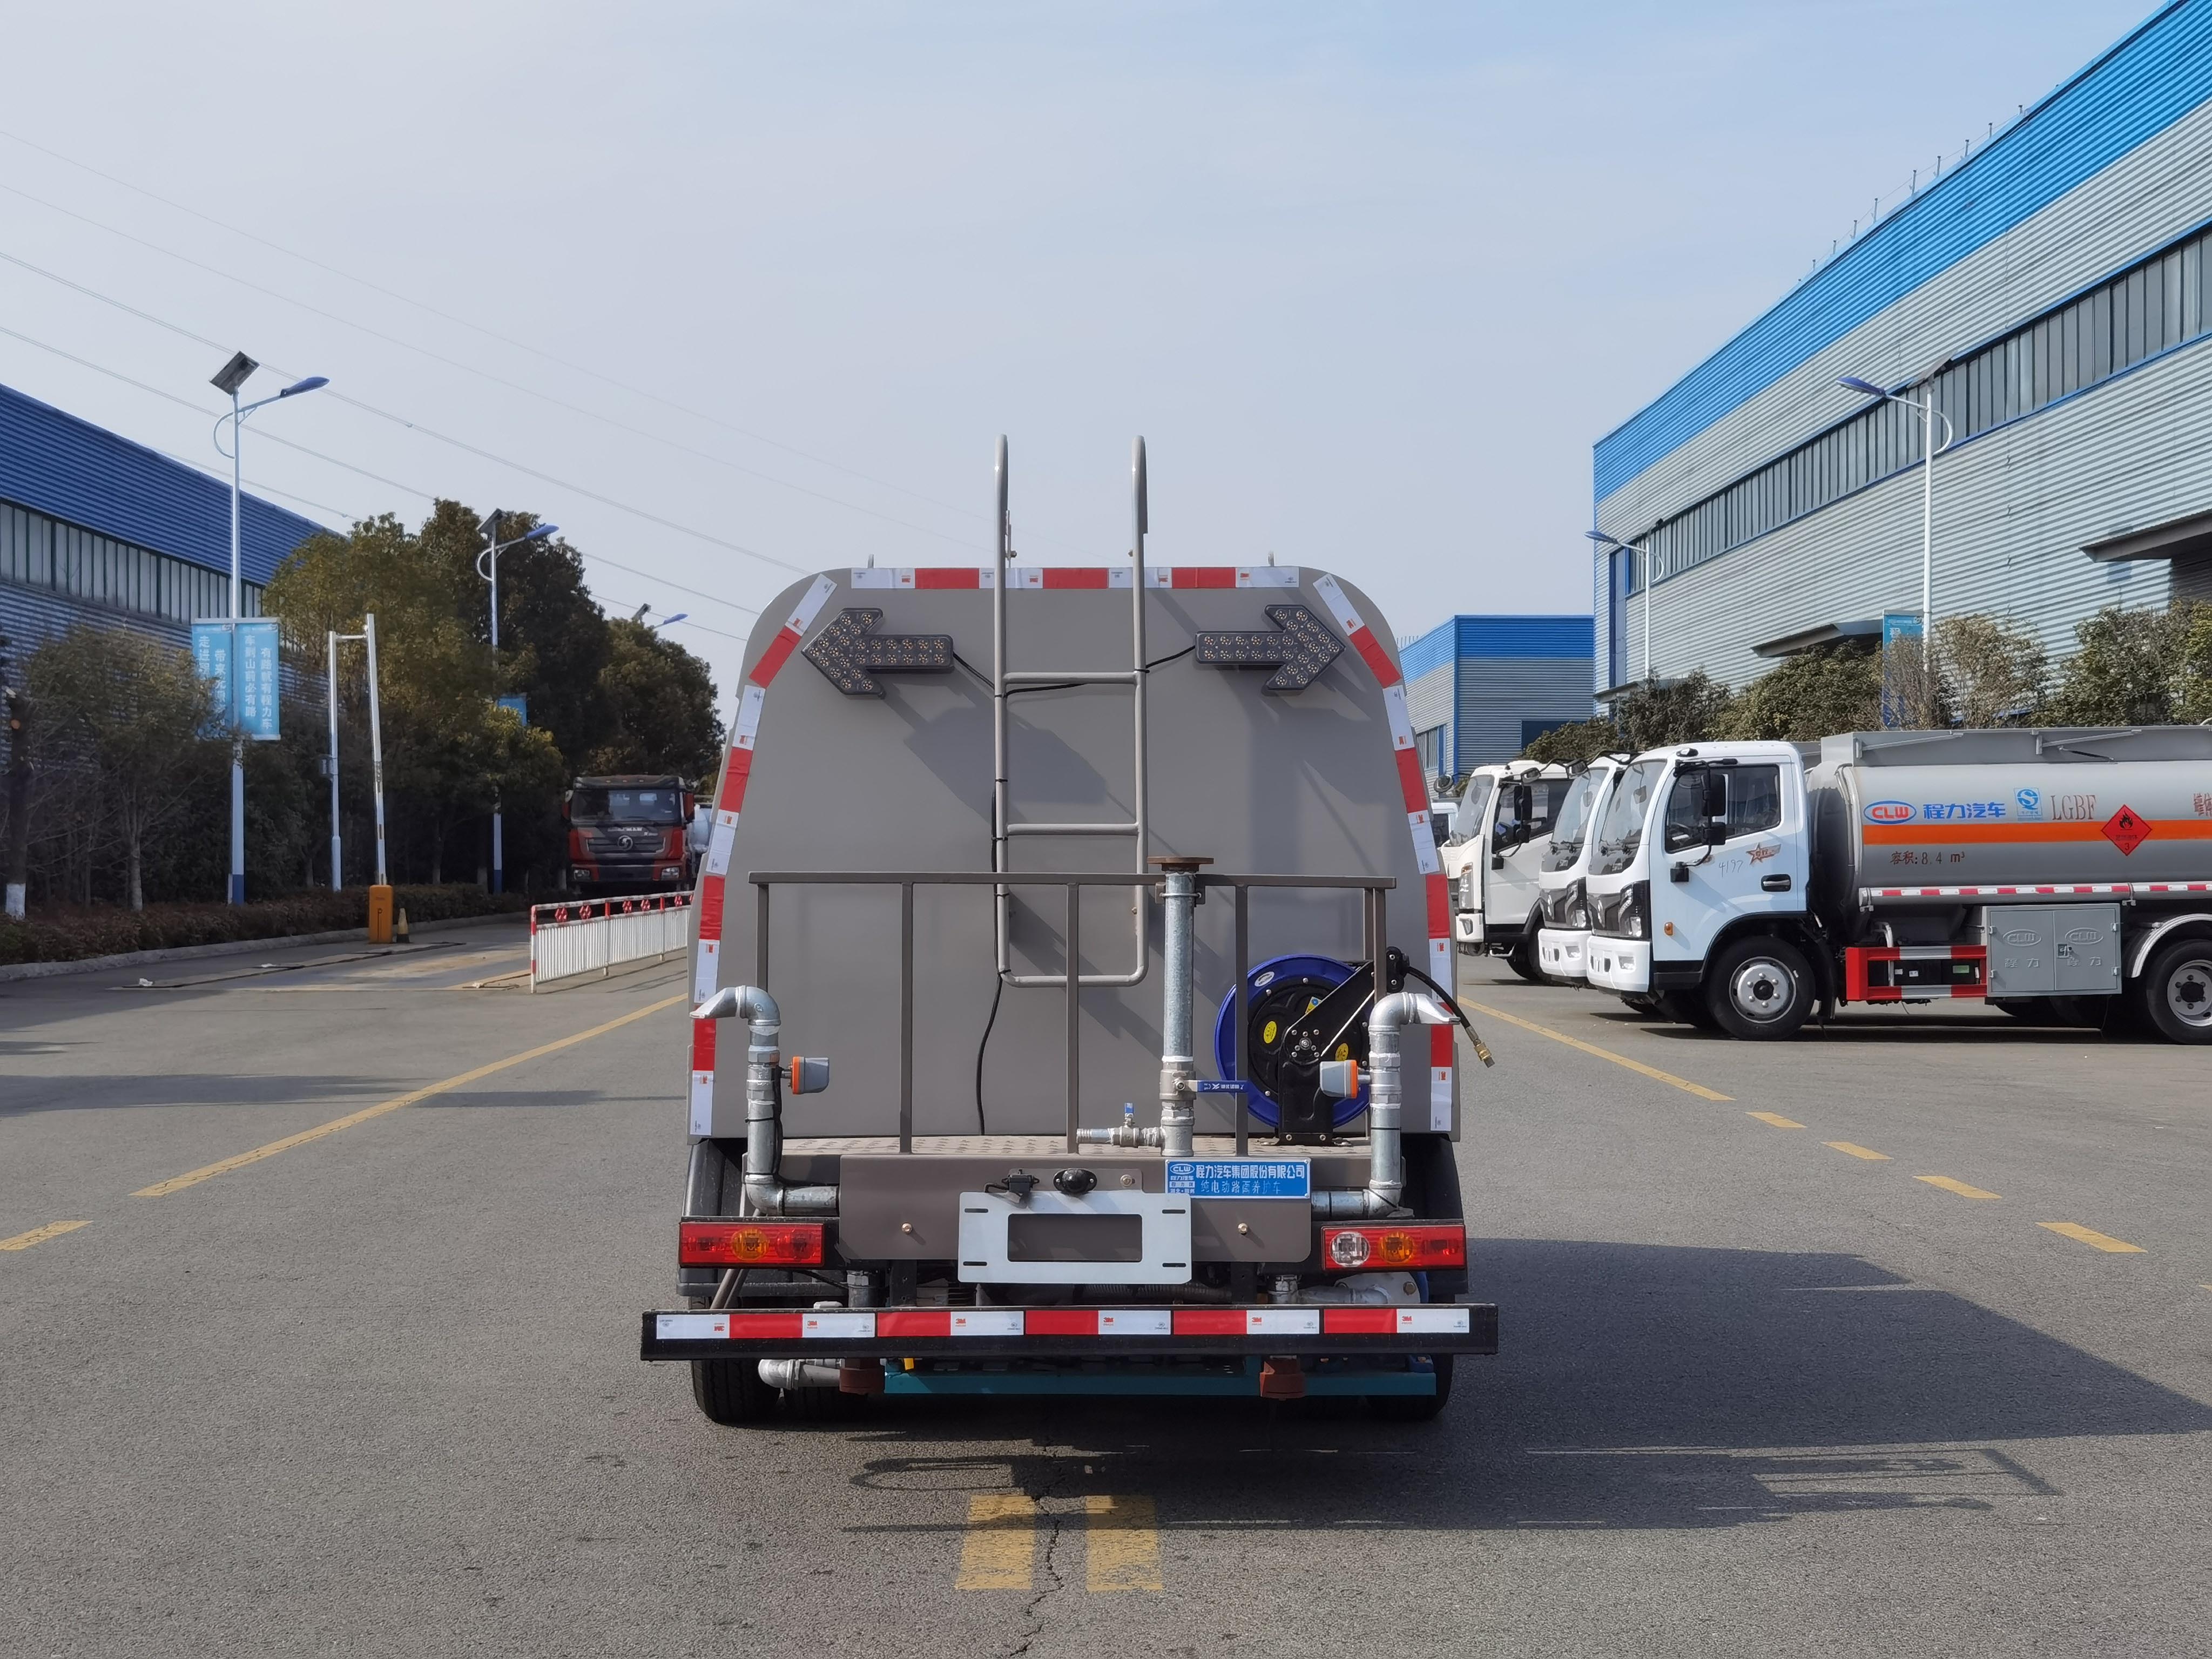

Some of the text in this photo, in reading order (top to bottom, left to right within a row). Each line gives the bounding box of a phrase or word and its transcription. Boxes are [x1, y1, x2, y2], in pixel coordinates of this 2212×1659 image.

[1872, 806, 1910, 819] CLW
[1923, 802, 2006, 819] 程力汽车
[2050, 794, 2096, 820] LGBF
[1718, 859, 1743, 878] 4197
[1196, 1164, 1305, 1179] 程力汽车集团股份有限公司
